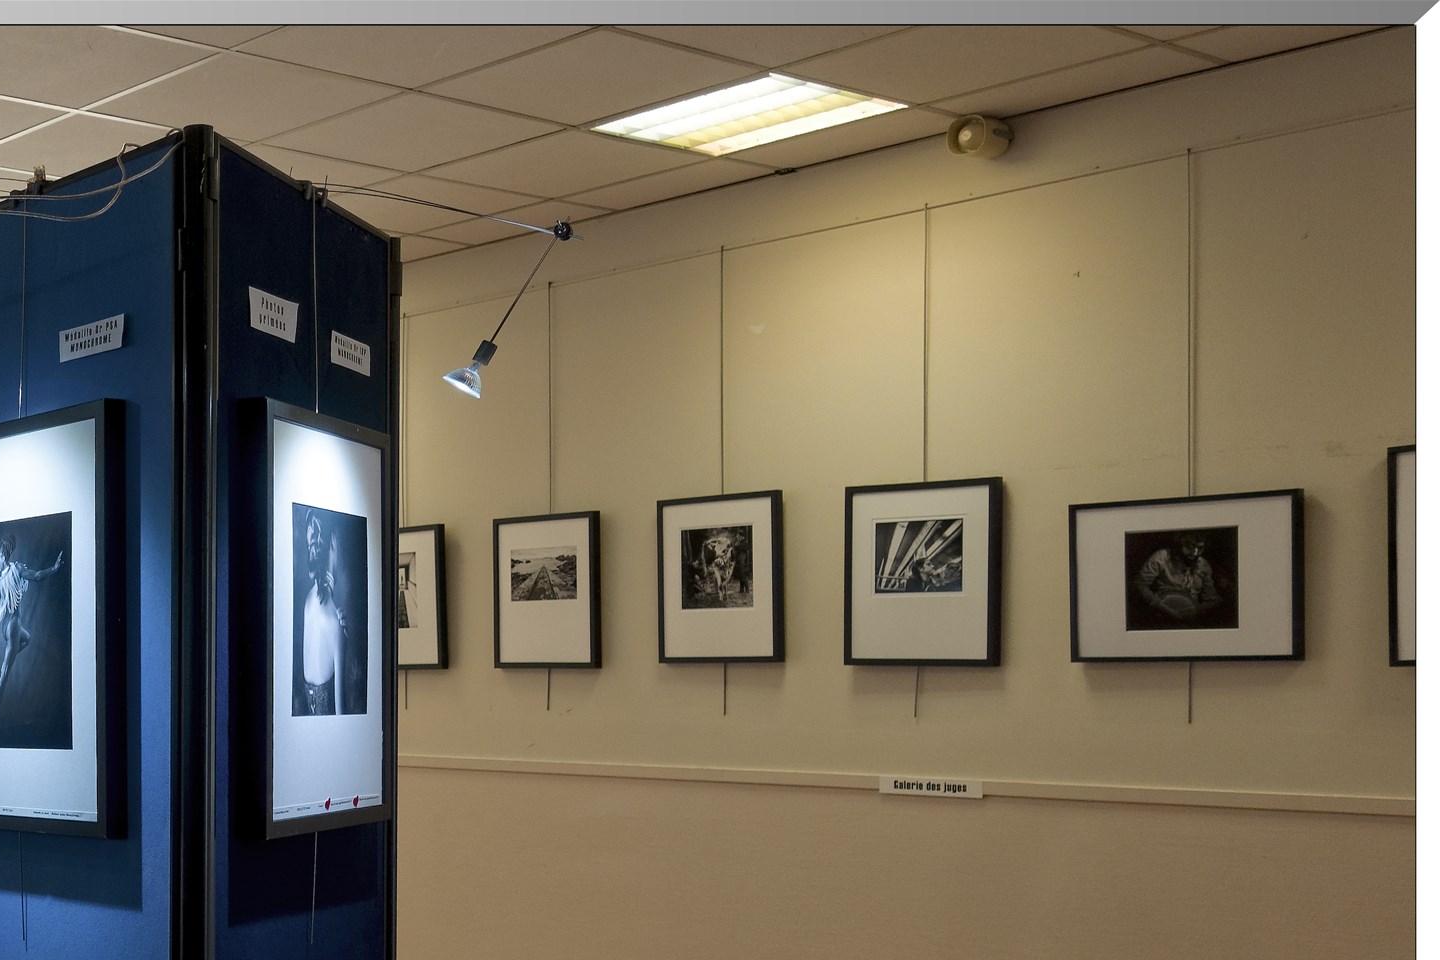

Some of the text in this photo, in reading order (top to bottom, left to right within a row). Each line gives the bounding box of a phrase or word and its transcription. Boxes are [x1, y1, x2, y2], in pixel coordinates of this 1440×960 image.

[261, 296, 284, 316] Photos
[105, 319, 118, 332] PSA
[70, 333, 112, 353] MONOCHROME
[893, 780, 967, 793] Galerie des juges
